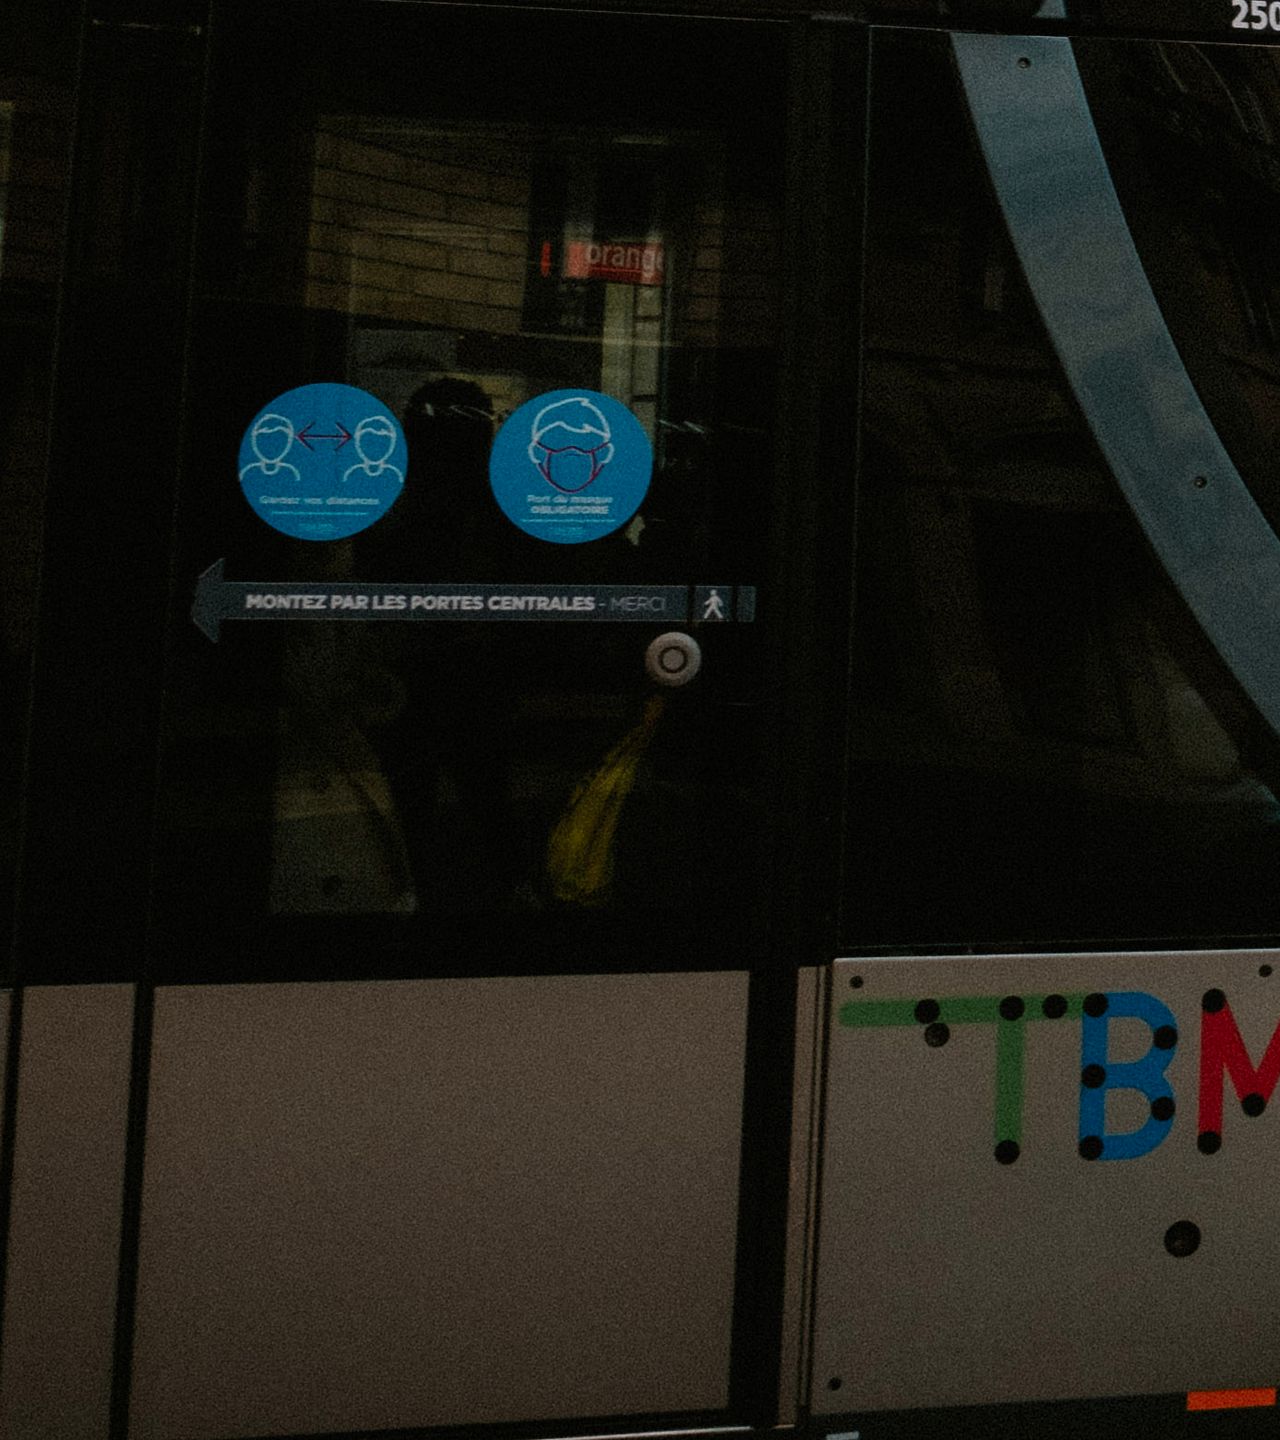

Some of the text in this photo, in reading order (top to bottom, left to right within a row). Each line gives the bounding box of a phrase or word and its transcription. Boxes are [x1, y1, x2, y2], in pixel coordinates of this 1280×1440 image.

[246, 594, 327, 609] MONTEZ
[330, 595, 369, 610] PAR
[372, 595, 406, 610] LES
[410, 595, 484, 610] PORTES
[487, 596, 596, 611] CENTRALES
[610, 596, 666, 611] MERCI
